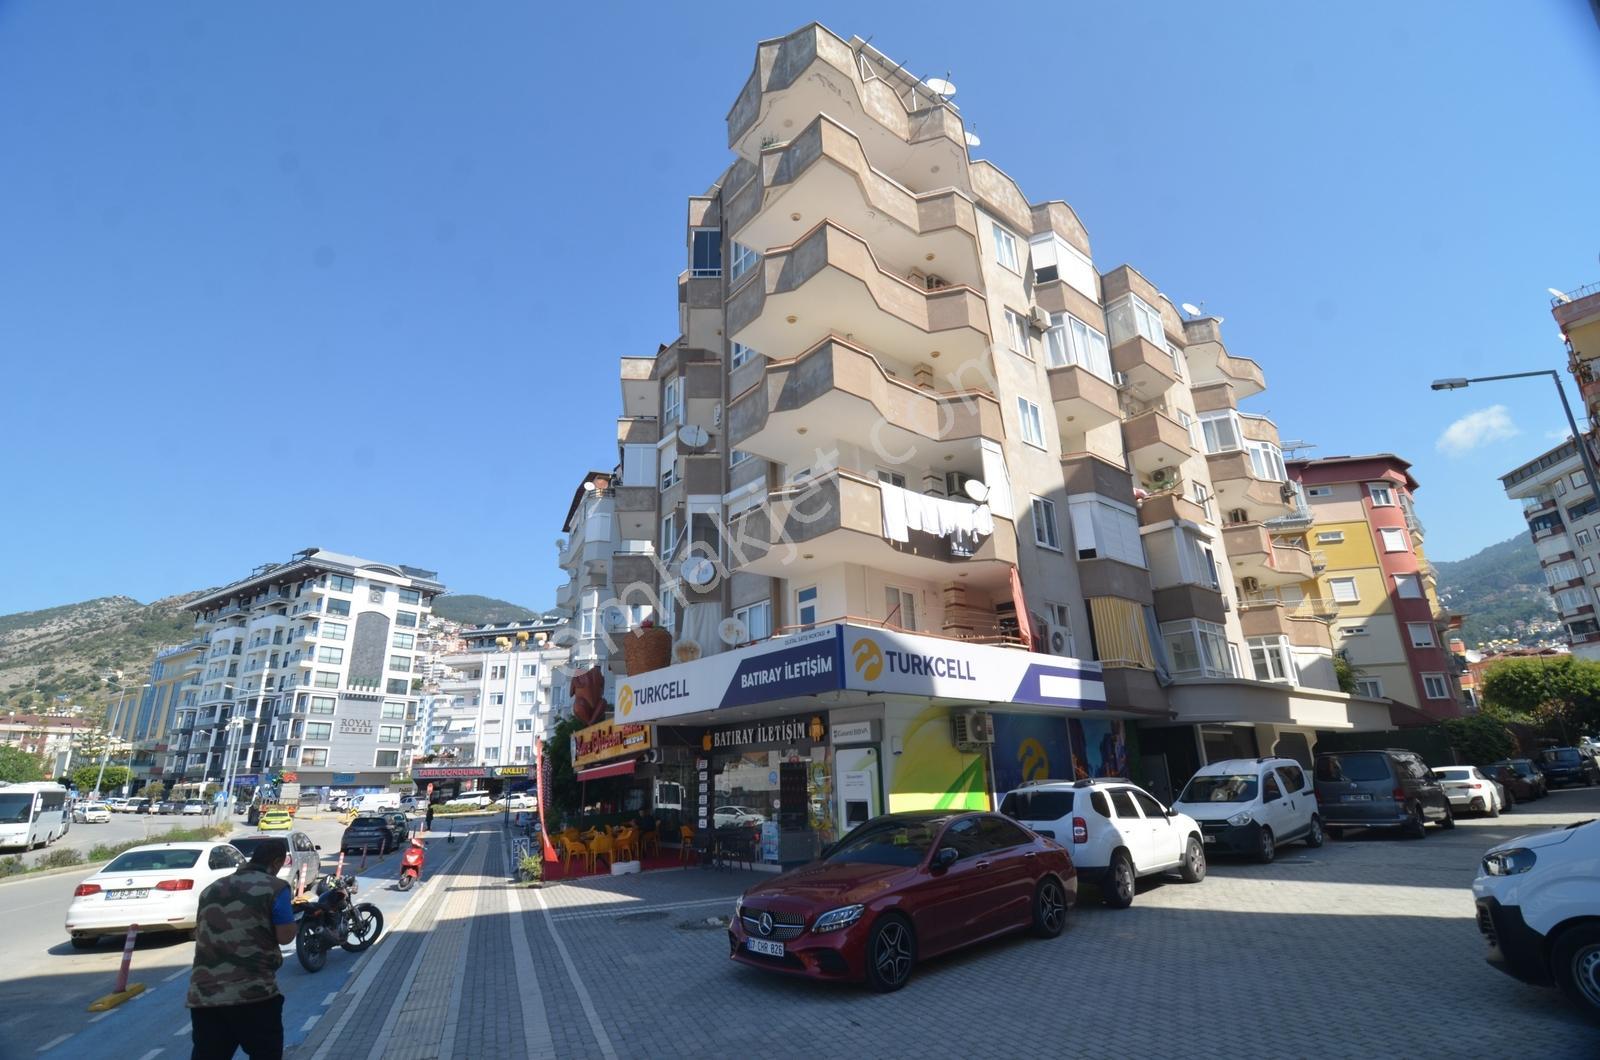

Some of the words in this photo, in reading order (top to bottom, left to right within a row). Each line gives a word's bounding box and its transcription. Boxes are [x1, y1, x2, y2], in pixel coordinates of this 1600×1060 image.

[741, 666, 781, 688] BATIRAY
[784, 654, 833, 680] İLETİŞİM
[884, 650, 977, 681] TURKCELL
[633, 679, 690, 706] TURKCELL
[341, 718, 372, 728] ROYAL
[714, 728, 753, 747] BATIRAY
[758, 719, 806, 745] İLETİŞİM
[330, 789, 347, 797] beko
[771, 944, 783, 955] 826
